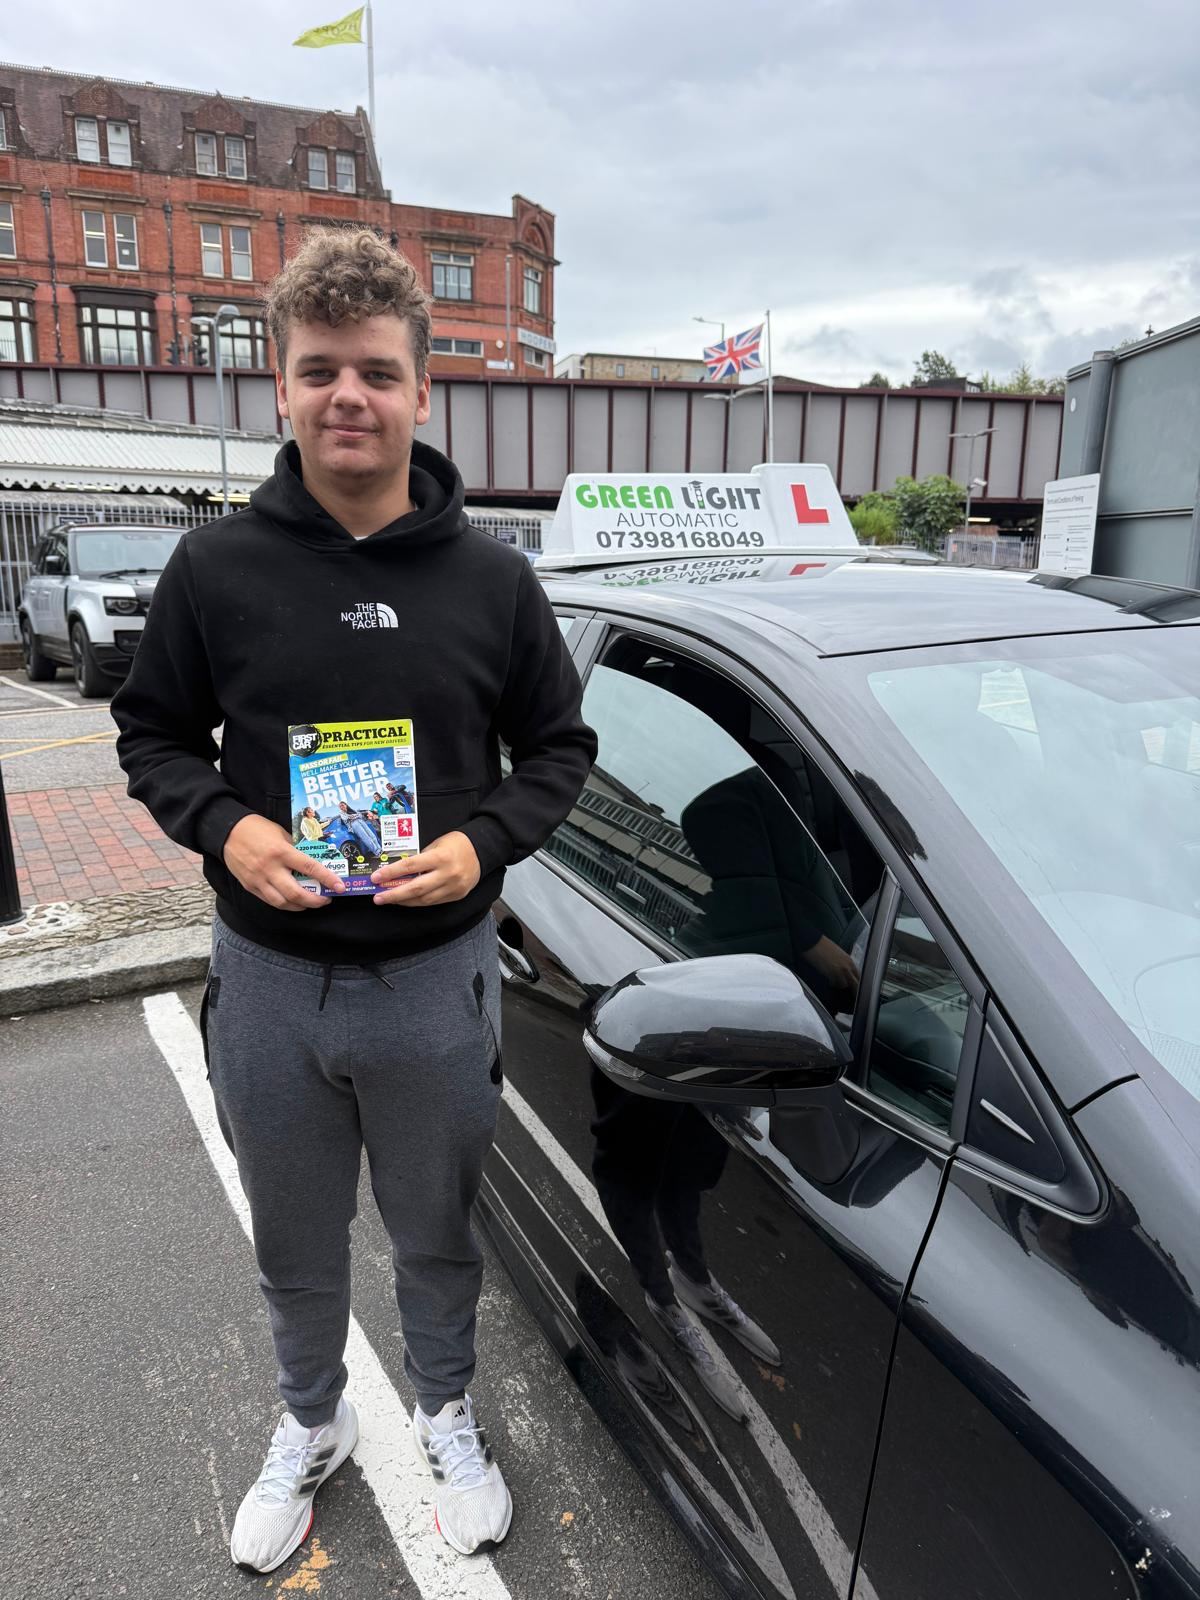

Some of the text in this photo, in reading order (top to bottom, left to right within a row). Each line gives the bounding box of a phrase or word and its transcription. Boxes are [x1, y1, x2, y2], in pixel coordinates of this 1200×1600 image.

[576, 481, 761, 510] GREEN LIGHT
[790, 484, 829, 524] L
[616, 512, 738, 528] AUTOMATIC
[596, 531, 764, 549] 07398168049
[354, 602, 376, 612] THE
[340, 610, 377, 622] NORTH
[352, 619, 378, 630] FACE
[292, 732, 317, 743] FIRST
[322, 726, 407, 743] PRACTICAL
[292, 741, 312, 750] CAR
[319, 763, 339, 773] MAKE
[339, 760, 353, 769] YOU
[302, 760, 388, 794] BETTER
[307, 776, 390, 811] DRIVER
